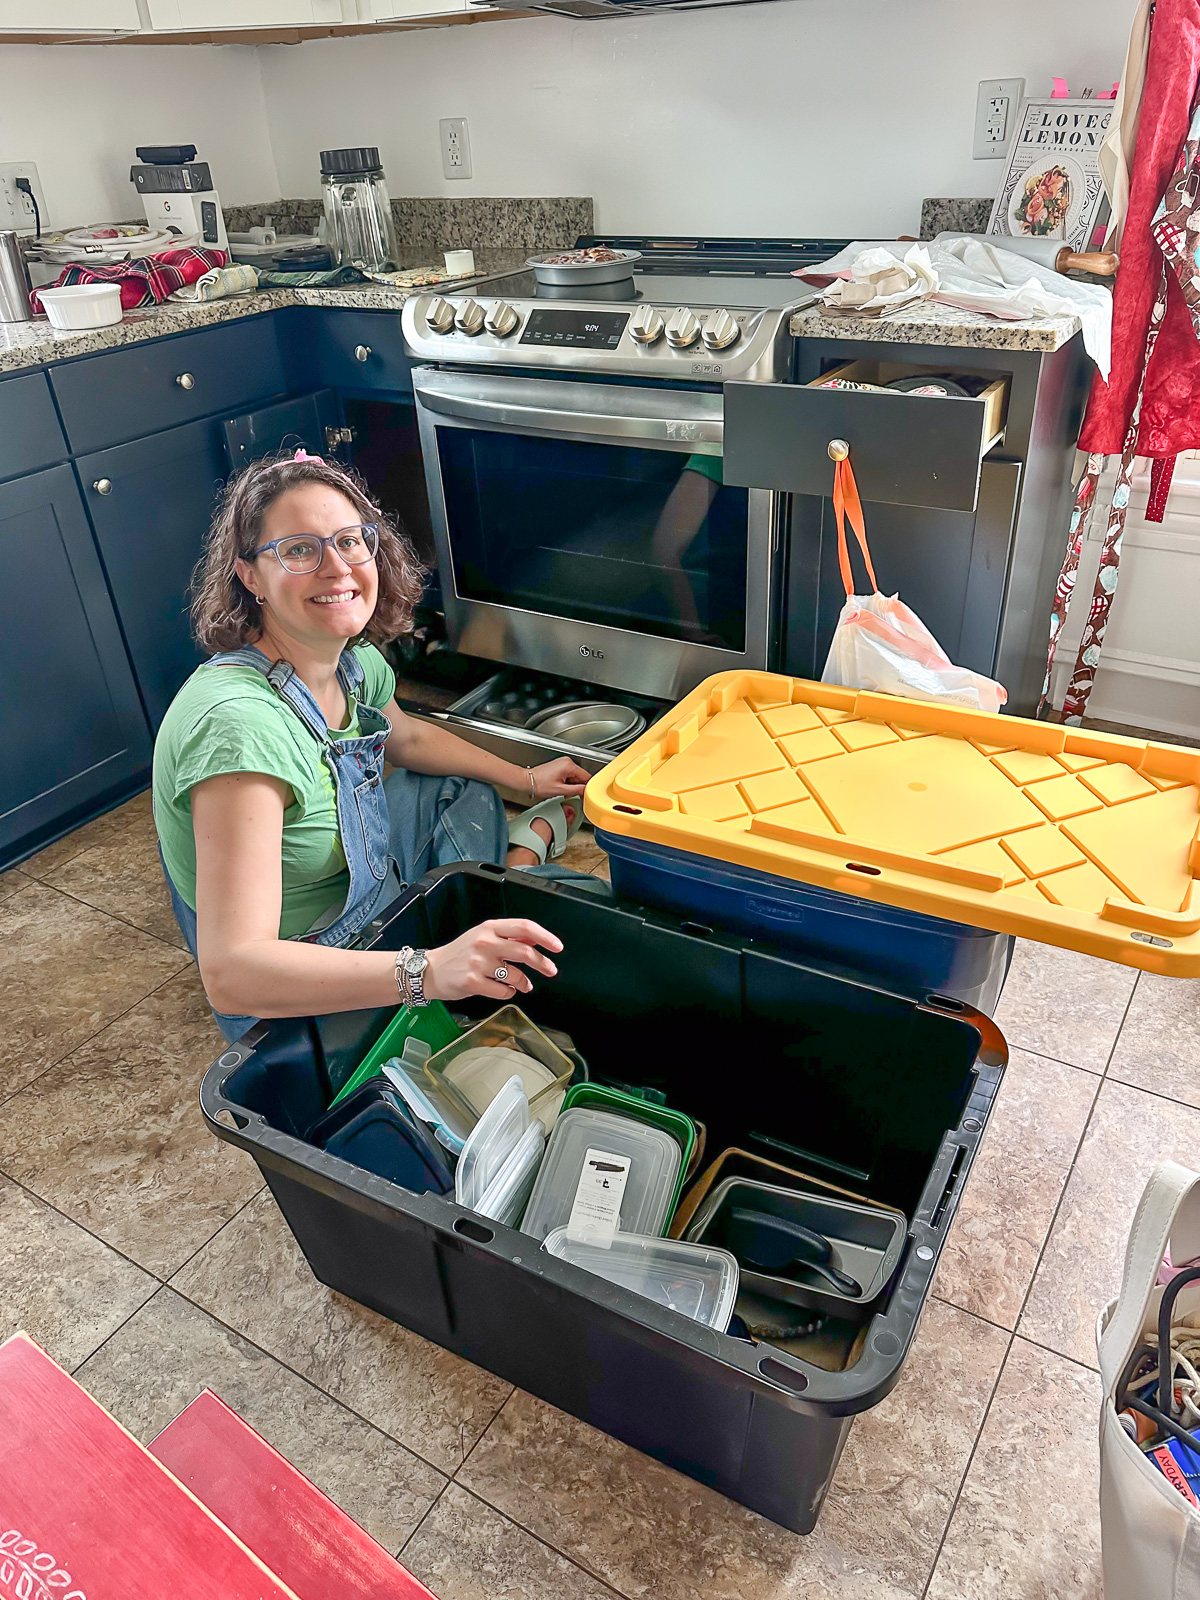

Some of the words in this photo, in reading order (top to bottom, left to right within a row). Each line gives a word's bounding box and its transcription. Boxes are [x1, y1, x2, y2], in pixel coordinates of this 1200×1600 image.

[1041, 113, 1099, 128] LOVE
[1022, 130, 1105, 146] LEMON
[591, 649, 604, 660] LG
[1159, 1455, 1192, 1503] ERYDAY
